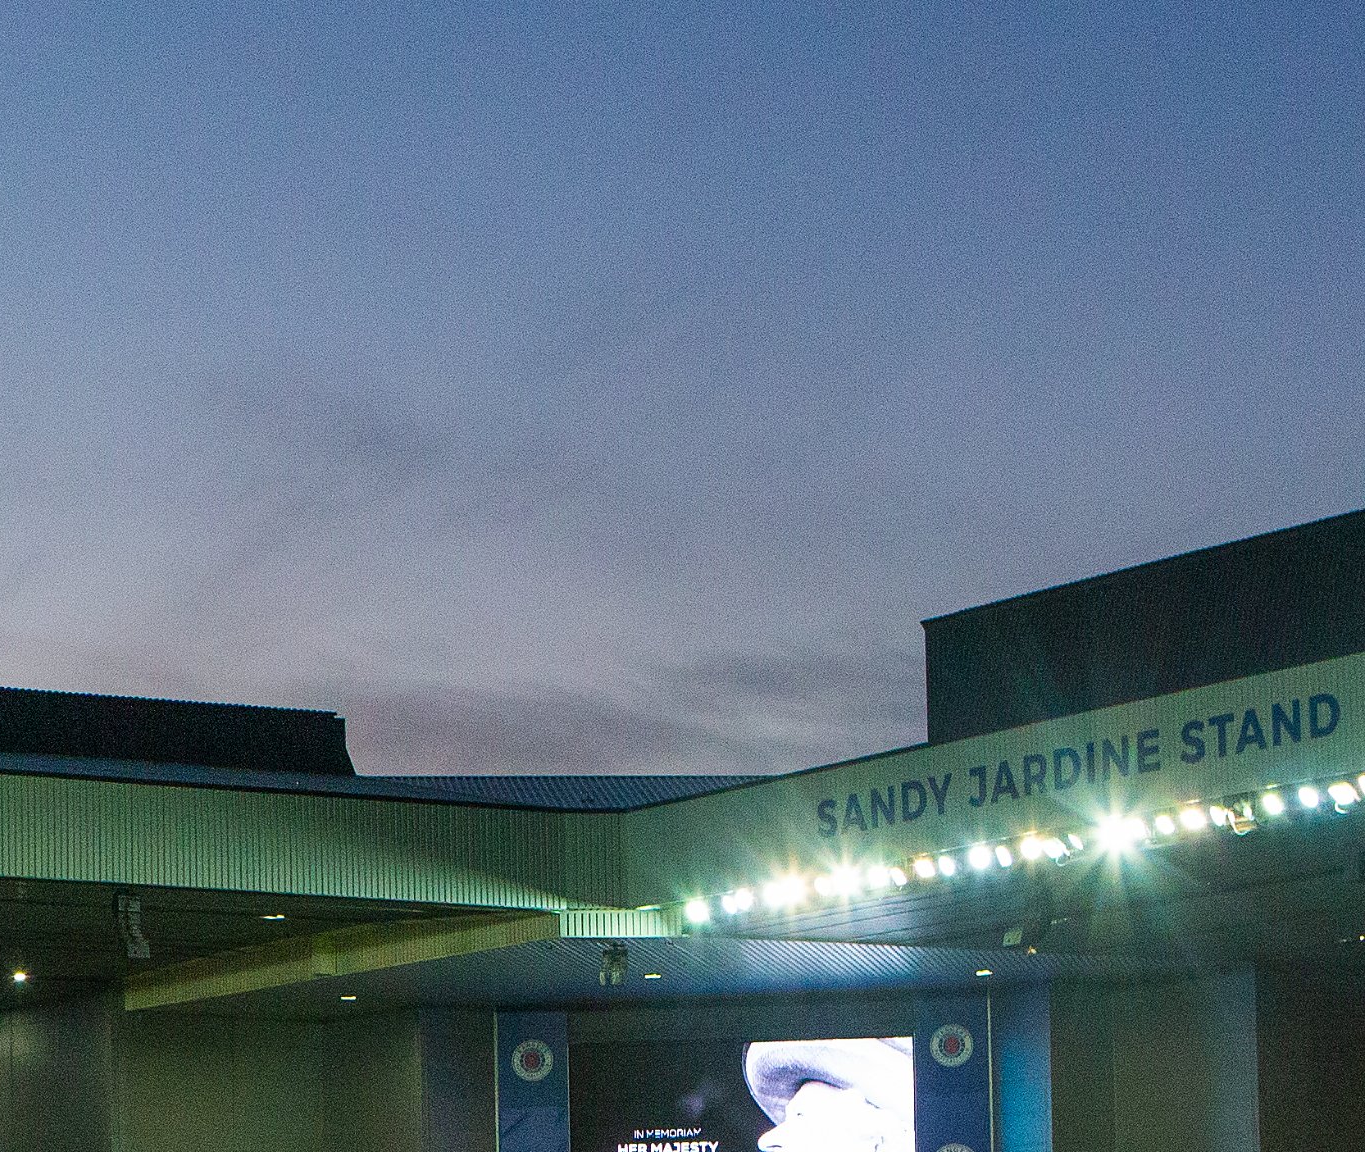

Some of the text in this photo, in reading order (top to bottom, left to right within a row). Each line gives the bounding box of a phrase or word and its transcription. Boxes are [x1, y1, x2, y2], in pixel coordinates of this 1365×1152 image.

[817, 692, 1342, 838] SANDY JARDINE STAND
[634, 1127, 702, 1139] IN MEMORIAM
